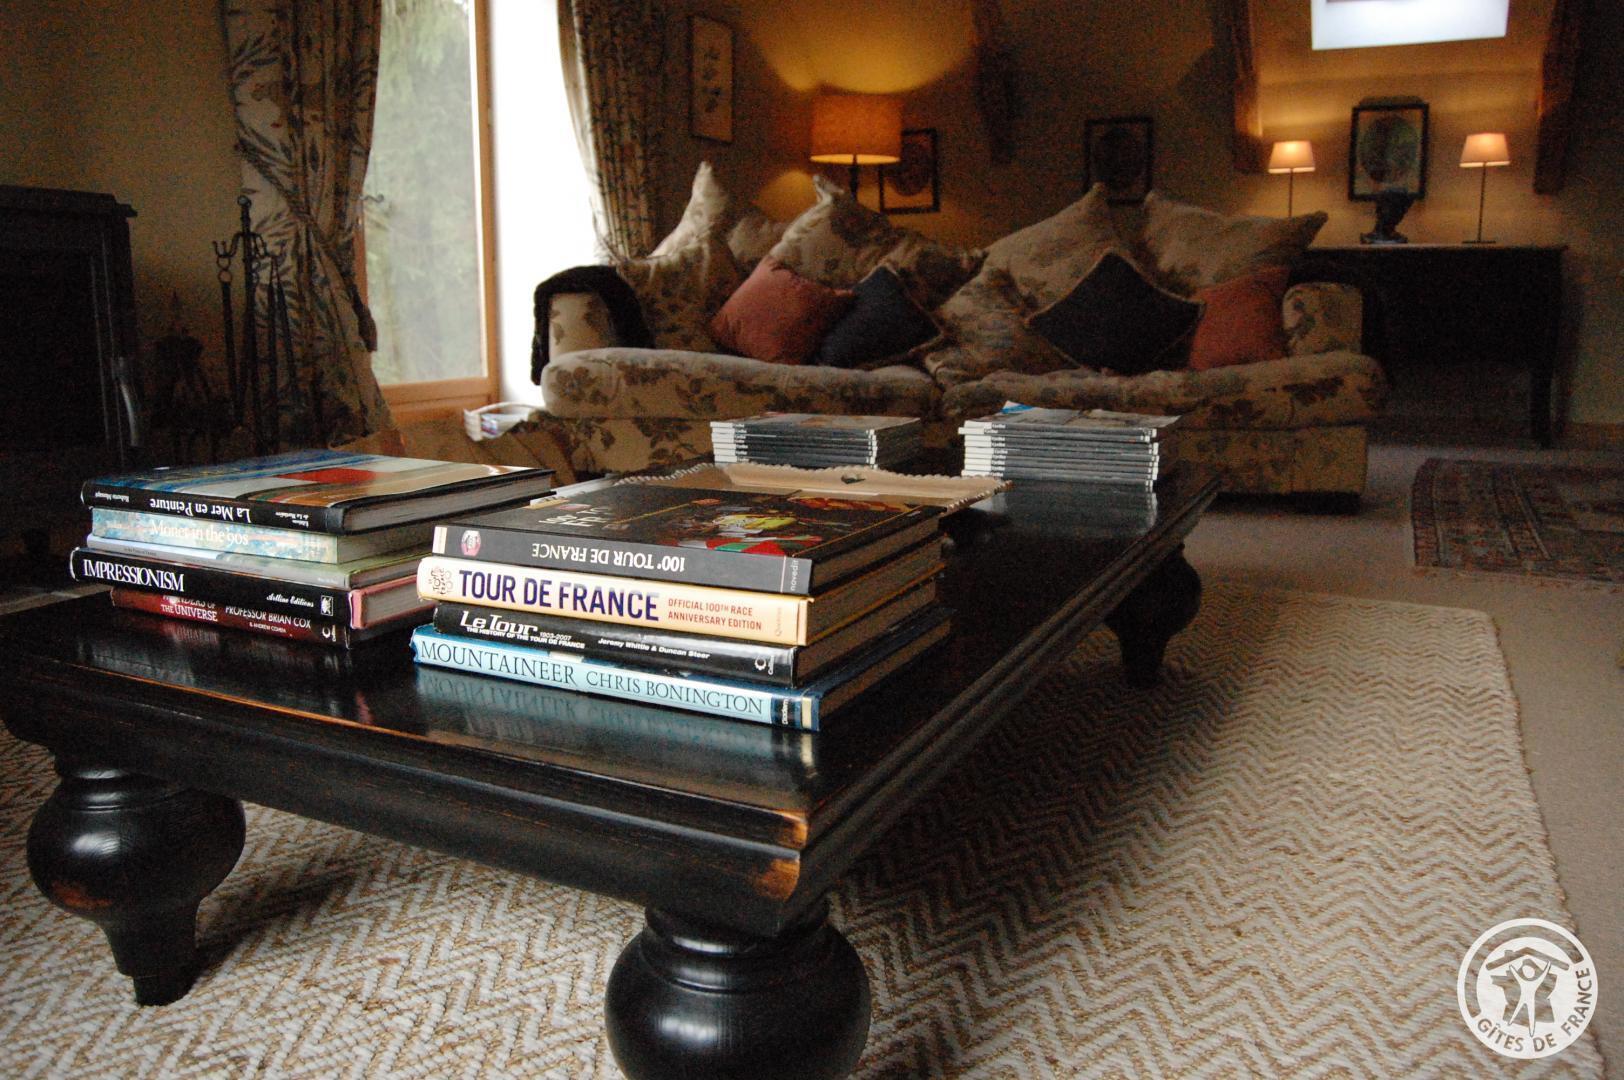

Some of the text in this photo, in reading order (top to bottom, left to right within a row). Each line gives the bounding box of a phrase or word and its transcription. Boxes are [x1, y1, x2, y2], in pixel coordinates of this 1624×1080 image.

[149, 498, 252, 524] La Mer en Peinture
[150, 519, 188, 537] Monet
[205, 524, 225, 542] the
[531, 543, 587, 562] FRANCE
[590, 548, 609, 565] DE
[613, 550, 654, 570] TOUR
[83, 559, 185, 592] IMPRESSIONISM
[458, 569, 660, 622] TOUR DE FRANCE
[160, 604, 218, 622] THE UNIVERSE
[225, 605, 312, 629] PROFESSOR BRIAN COX
[668, 598, 703, 610] OFFICIAL
[730, 605, 753, 617] RACE
[460, 610, 487, 629] Le
[489, 614, 539, 635] Tour
[668, 610, 762, 631] ANNIVERSARY EDITION
[479, 628, 506, 637] HISTORY
[530, 635, 548, 643] TOUR
[558, 640, 586, 649] FRANCE
[598, 638, 625, 648] Jeremy
[625, 641, 650, 651] Whittle
[658, 646, 687, 656] Duncan
[421, 641, 763, 715] MOUNTAINEER CHRIS BONINGTON
